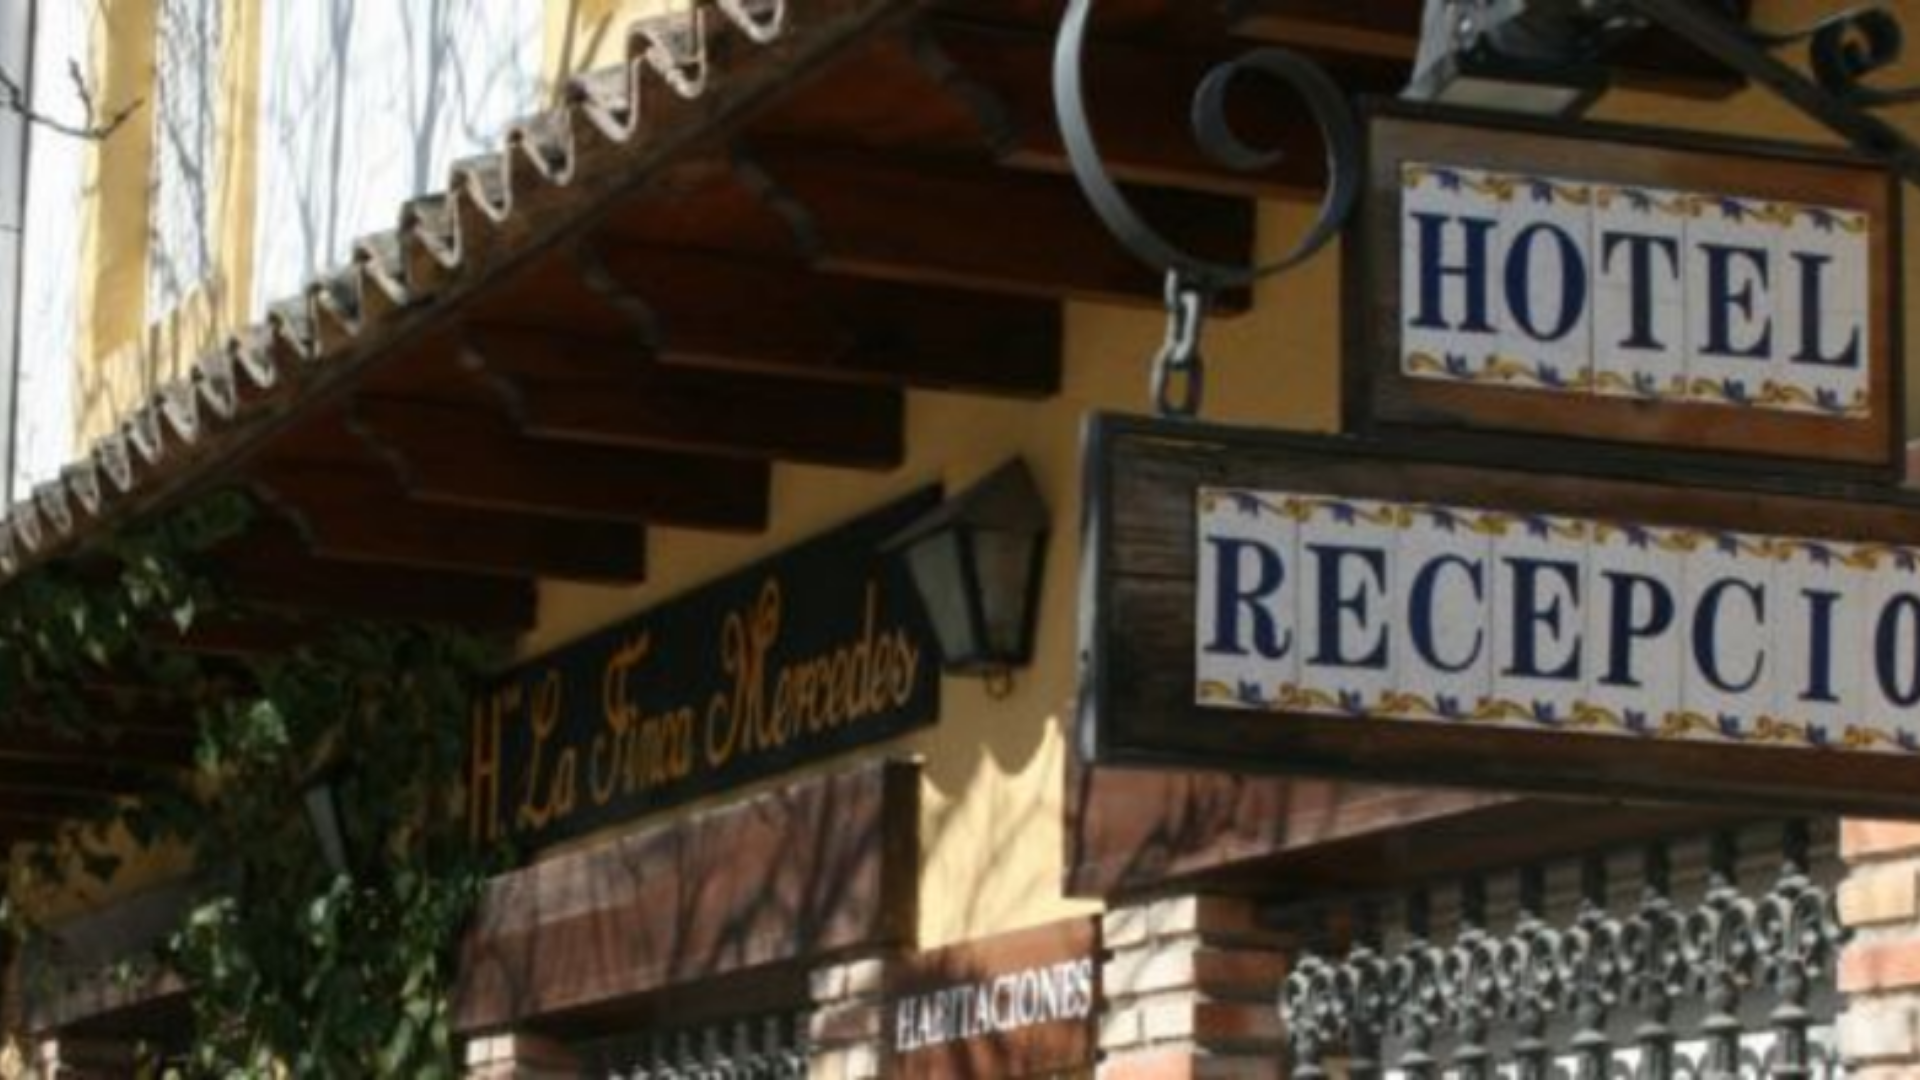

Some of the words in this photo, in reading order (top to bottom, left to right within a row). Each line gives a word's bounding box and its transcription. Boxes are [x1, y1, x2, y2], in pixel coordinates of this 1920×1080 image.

[1409, 211, 1860, 368] HOTEL
[515, 668, 576, 830] La
[705, 577, 919, 767] Mercedes
[1203, 535, 1920, 708] RECEPCIO
[896, 957, 1093, 1051] HABITACIONES
